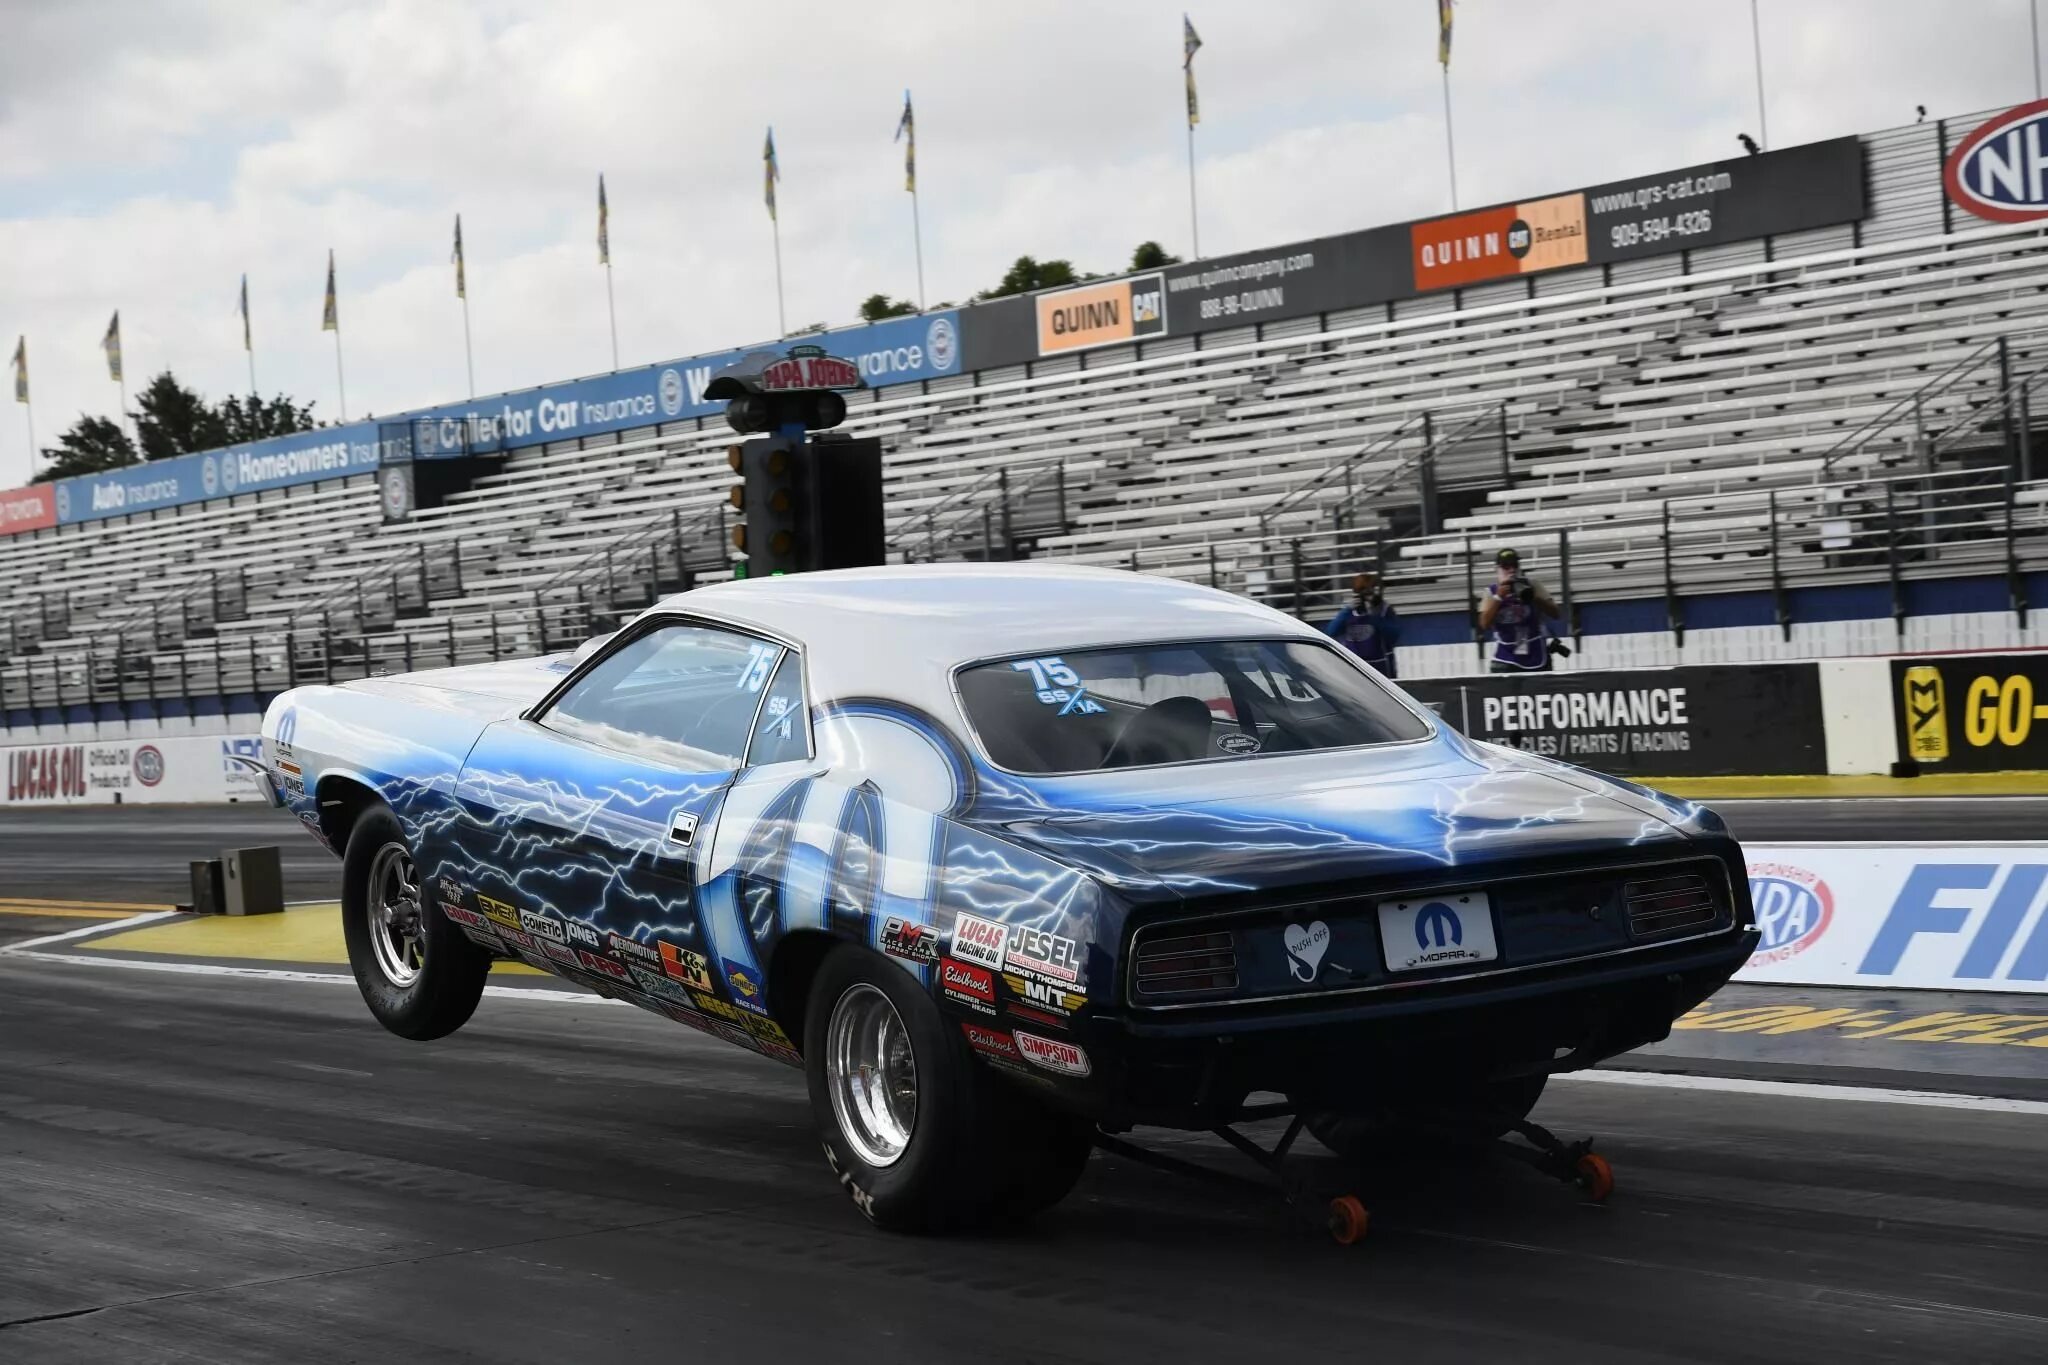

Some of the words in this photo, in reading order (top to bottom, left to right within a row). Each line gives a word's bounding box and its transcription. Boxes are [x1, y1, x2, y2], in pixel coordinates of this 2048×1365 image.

[1591, 172, 1732, 214] www.qrs-cat.com
[1535, 220, 1582, 244] Rental
[1610, 209, 1712, 248] 909-594-4326
[1421, 231, 1500, 268] QUINN
[1051, 299, 1120, 336] QUINN
[766, 359, 805, 388] PAPA
[440, 406, 532, 448] Collector
[538, 398, 578, 432] Car
[239, 442, 349, 484] Homeowners
[92, 482, 126, 511] Auto
[737, 643, 778, 693] 75
[1010, 656, 1081, 691] 75
[1483, 688, 1689, 731] PERFORMANCE
[1569, 733, 1619, 754] PARTS
[1631, 731, 1691, 752] RACING
[8, 749, 58, 800] LUCAS
[61, 746, 86, 797] OIL
[522, 914, 562, 938] COMETIC
[564, 920, 600, 947] JONES
[957, 918, 1004, 949] LUCAS
[955, 940, 983, 960] RACING
[985, 951, 1000, 964] OIL
[1008, 926, 1080, 972] JESEL
[1291, 937, 1313, 955] PUSH
[1313, 928, 1329, 944] OFF
[580, 950, 627, 978] ARP
[1008, 953, 1041, 970] VALVETRAIN
[1041, 960, 1074, 980] INNOVATION
[1419, 949, 1466, 964] MOPAR
[729, 975, 758, 995] SUNOCO
[944, 965, 990, 994] Edelbrock
[1003, 963, 1036, 979] MICKEY
[1036, 973, 1087, 994] THOMPSON
[735, 998, 751, 1009] RACE
[751, 1003, 768, 1016] FUELS
[944, 988, 980, 1005] CYLINDER
[971, 1003, 997, 1016] HEADS
[968, 1029, 1016, 1054] Edelbrock
[1021, 1036, 1080, 1065] SIMPSON
